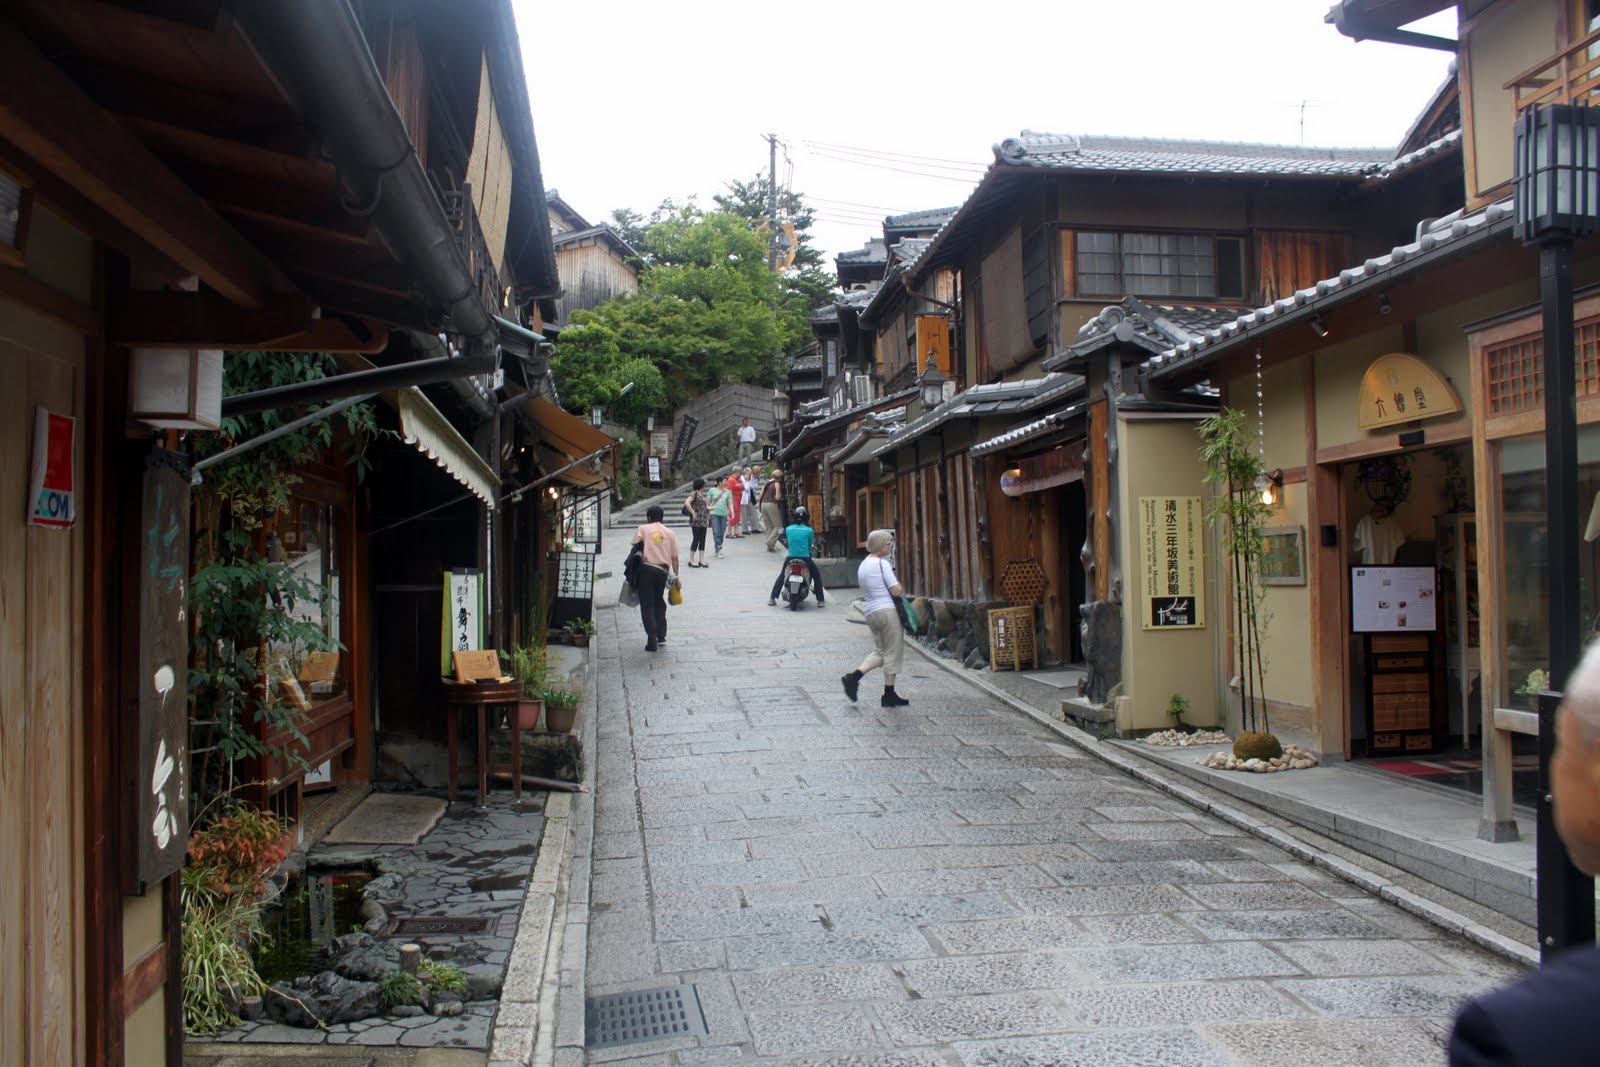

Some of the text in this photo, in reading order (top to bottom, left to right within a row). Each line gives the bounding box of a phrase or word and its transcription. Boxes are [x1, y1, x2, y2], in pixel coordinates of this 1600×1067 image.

[1165, 500, 1179, 595] 清水三年坂美術館
